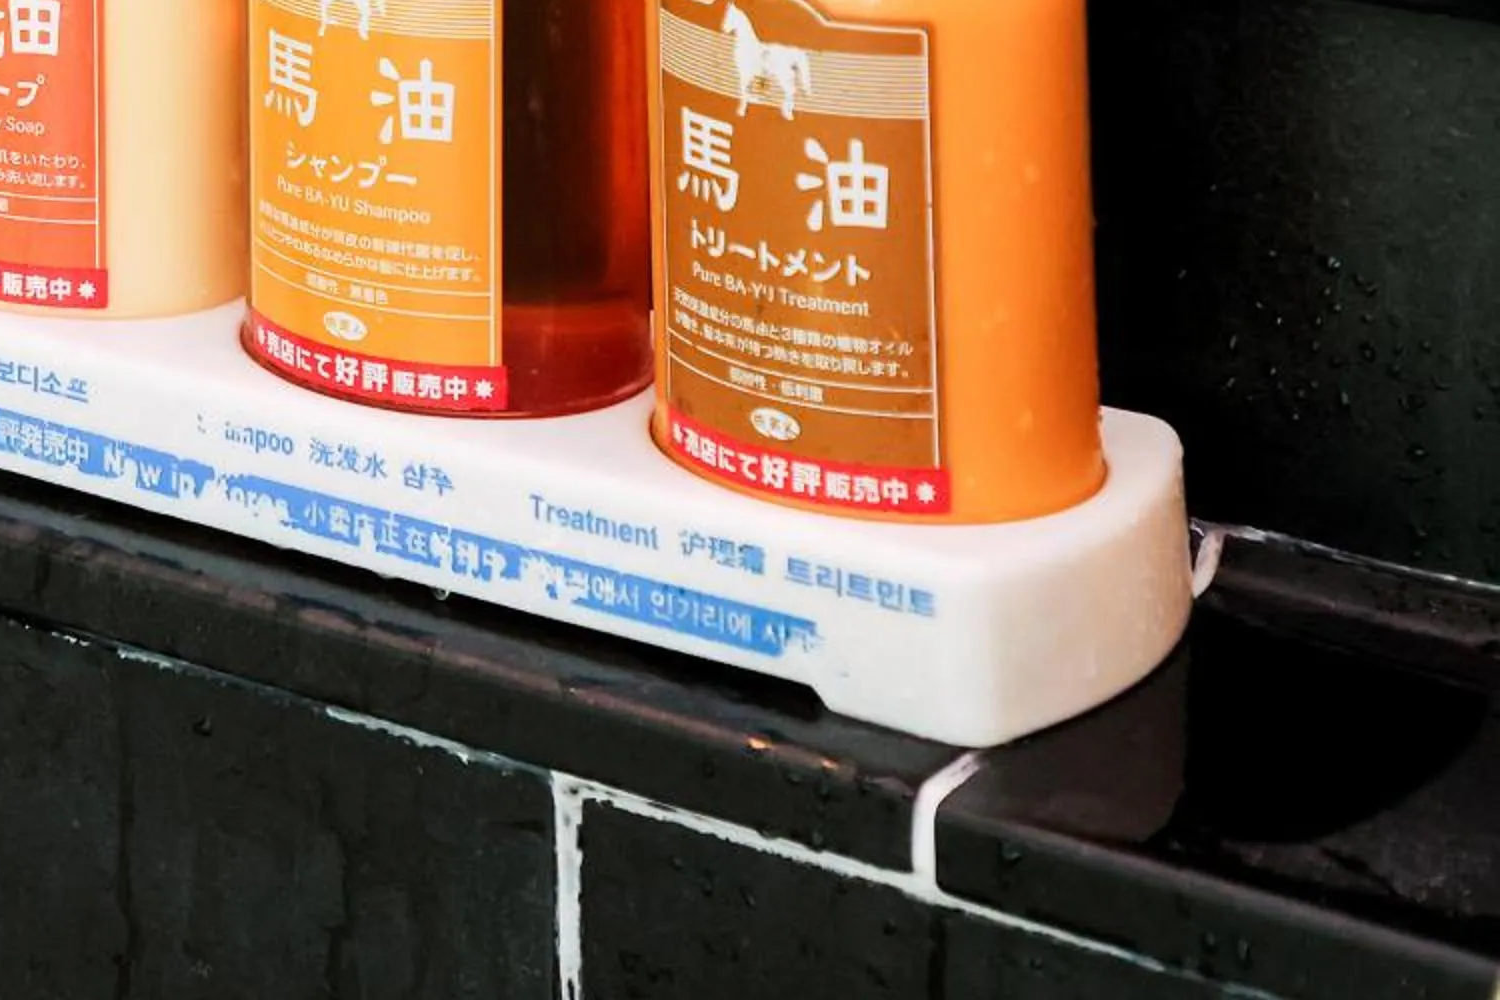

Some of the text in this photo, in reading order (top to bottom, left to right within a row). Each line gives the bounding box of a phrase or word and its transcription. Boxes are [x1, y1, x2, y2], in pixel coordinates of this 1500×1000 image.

[264, 27, 456, 145] 馬油
[5, 115, 45, 137] Soap
[286, 141, 418, 189] シャンプー
[676, 106, 889, 232] 馬油
[276, 175, 302, 200] Pure
[354, 199, 431, 226] Shampoo
[691, 219, 871, 287] トリートメント
[692, 261, 722, 288] Pure
[780, 287, 870, 317] Treatment
[309, 436, 388, 479] 洗发水
[528, 493, 660, 551] Treatment
[785, 555, 937, 618] 트리트먼트
[650, 588, 753, 643] 인기리에
